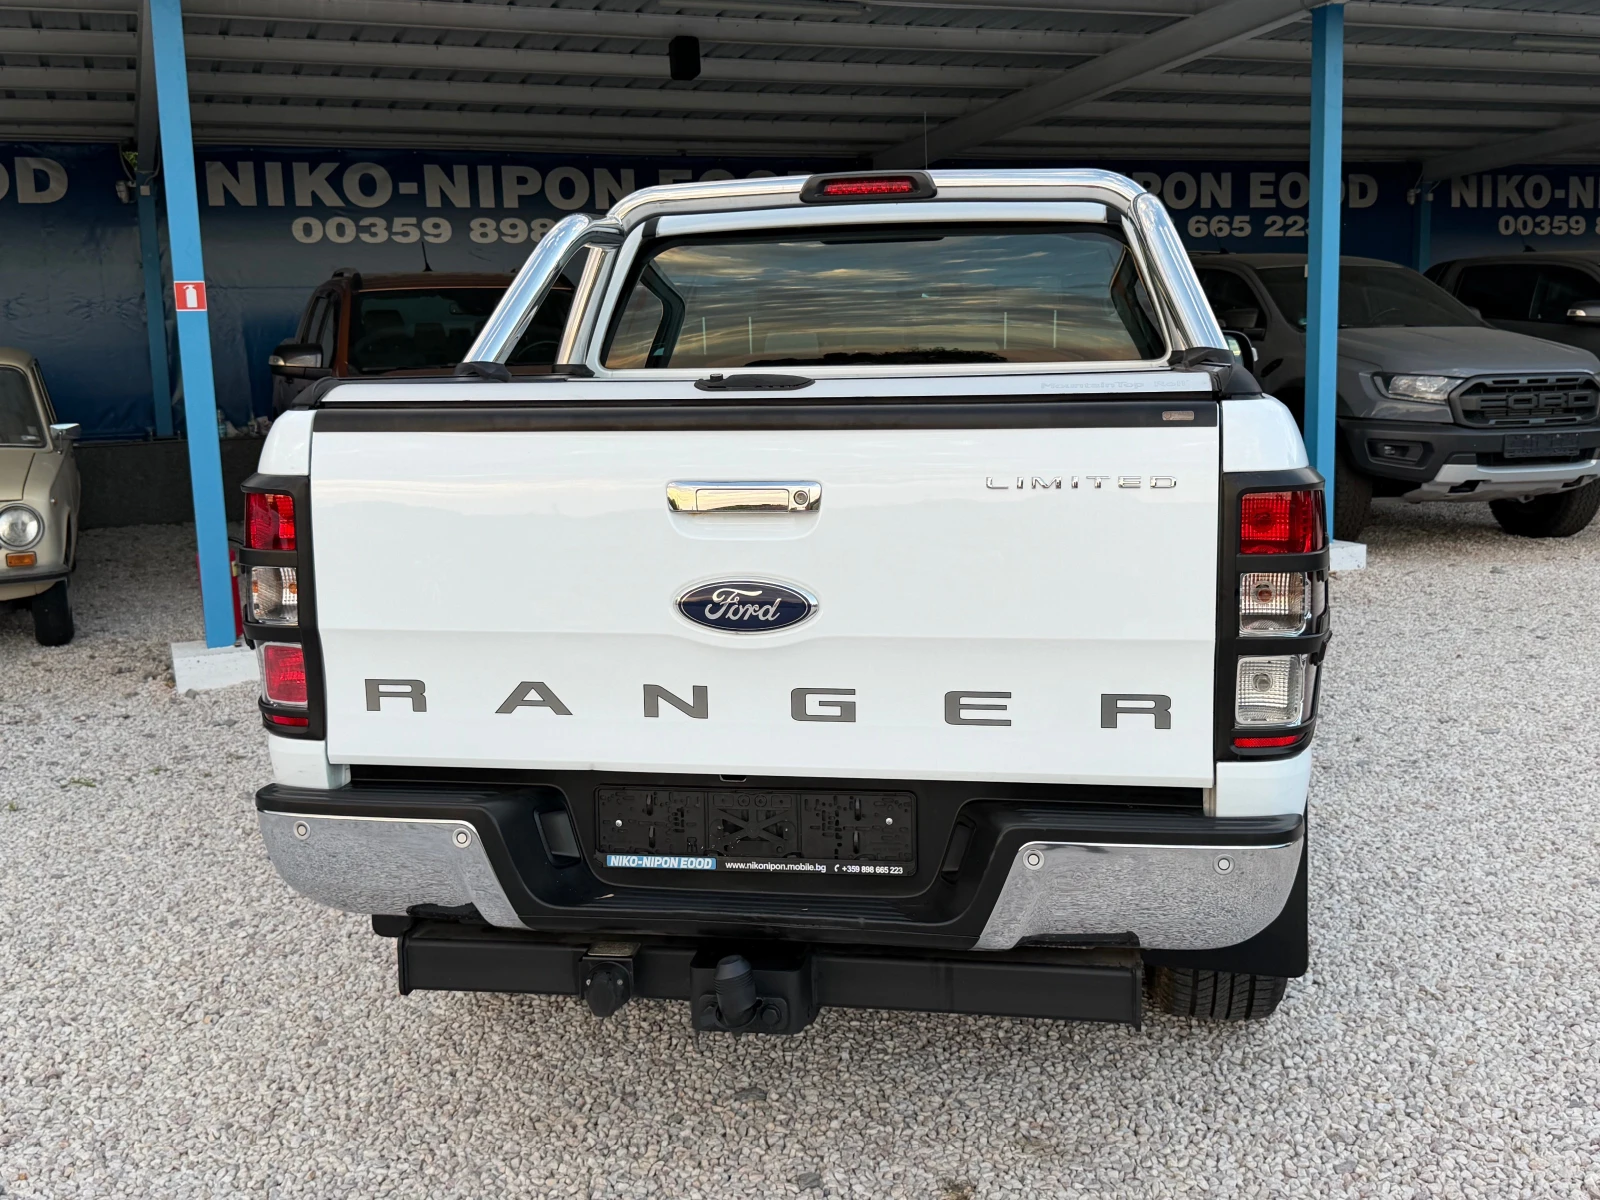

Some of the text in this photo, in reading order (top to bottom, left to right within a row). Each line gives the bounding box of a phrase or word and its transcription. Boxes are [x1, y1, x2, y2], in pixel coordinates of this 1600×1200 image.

[205, 160, 635, 210] NIKO-NIPON
[1249, 172, 1379, 209] EOD
[1451, 174, 1600, 209] NIKO-N
[291, 216, 453, 244] 00359
[1187, 215, 1252, 238] 665
[1263, 216, 1310, 237] 22
[1498, 214, 1587, 236] 00359
[985, 475, 1177, 489] LIMITED
[704, 587, 781, 622] Ford
[364, 678, 1172, 730] RANGER
[610, 855, 712, 869] NIKO-NIPON EOOD
[725, 861, 904, 875] www.nikonipon.mobile.bg +359 898 665 223
